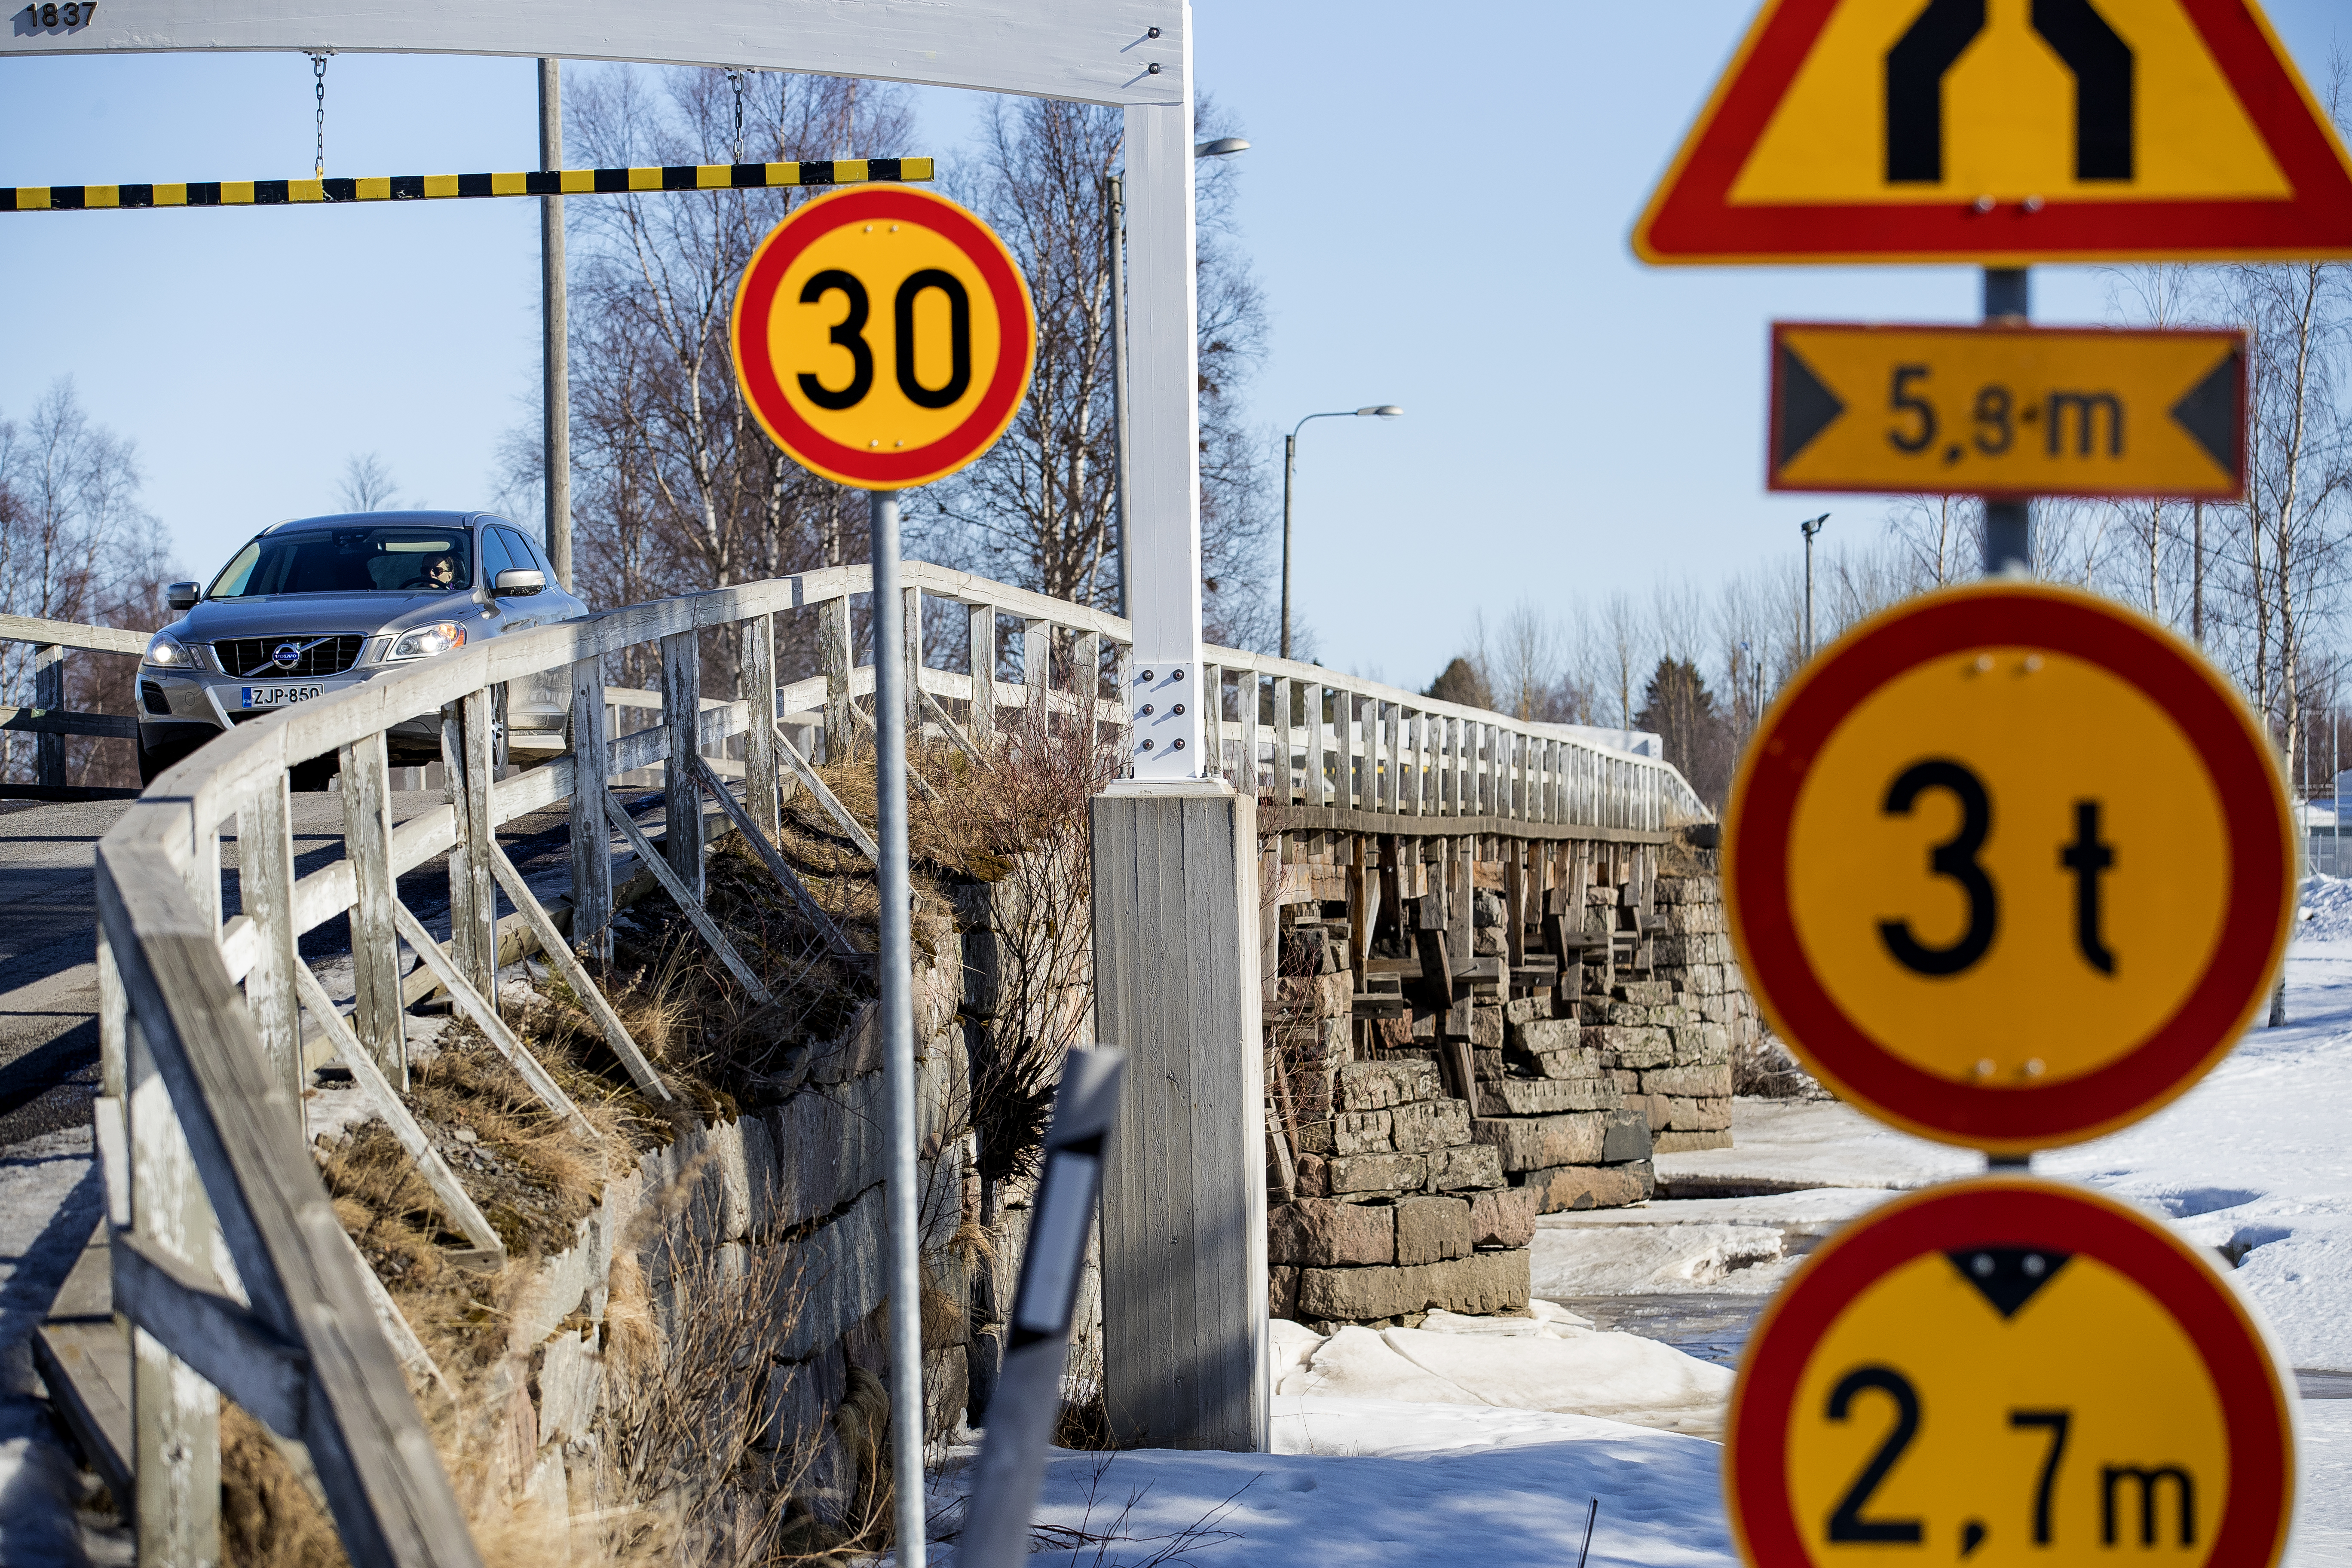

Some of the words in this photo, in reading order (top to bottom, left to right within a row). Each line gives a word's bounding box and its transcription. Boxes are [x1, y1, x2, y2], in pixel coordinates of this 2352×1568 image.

[27, 1, 99, 27] 1837
[796, 268, 972, 411] 30
[2047, 391, 2123, 457] m
[254, 687, 320, 704] ZJP-850
[1876, 756, 2000, 978] 3
[2060, 799, 2119, 976] t
[1825, 1365, 2071, 1557] 2,7
[2100, 1464, 2196, 1547] m
